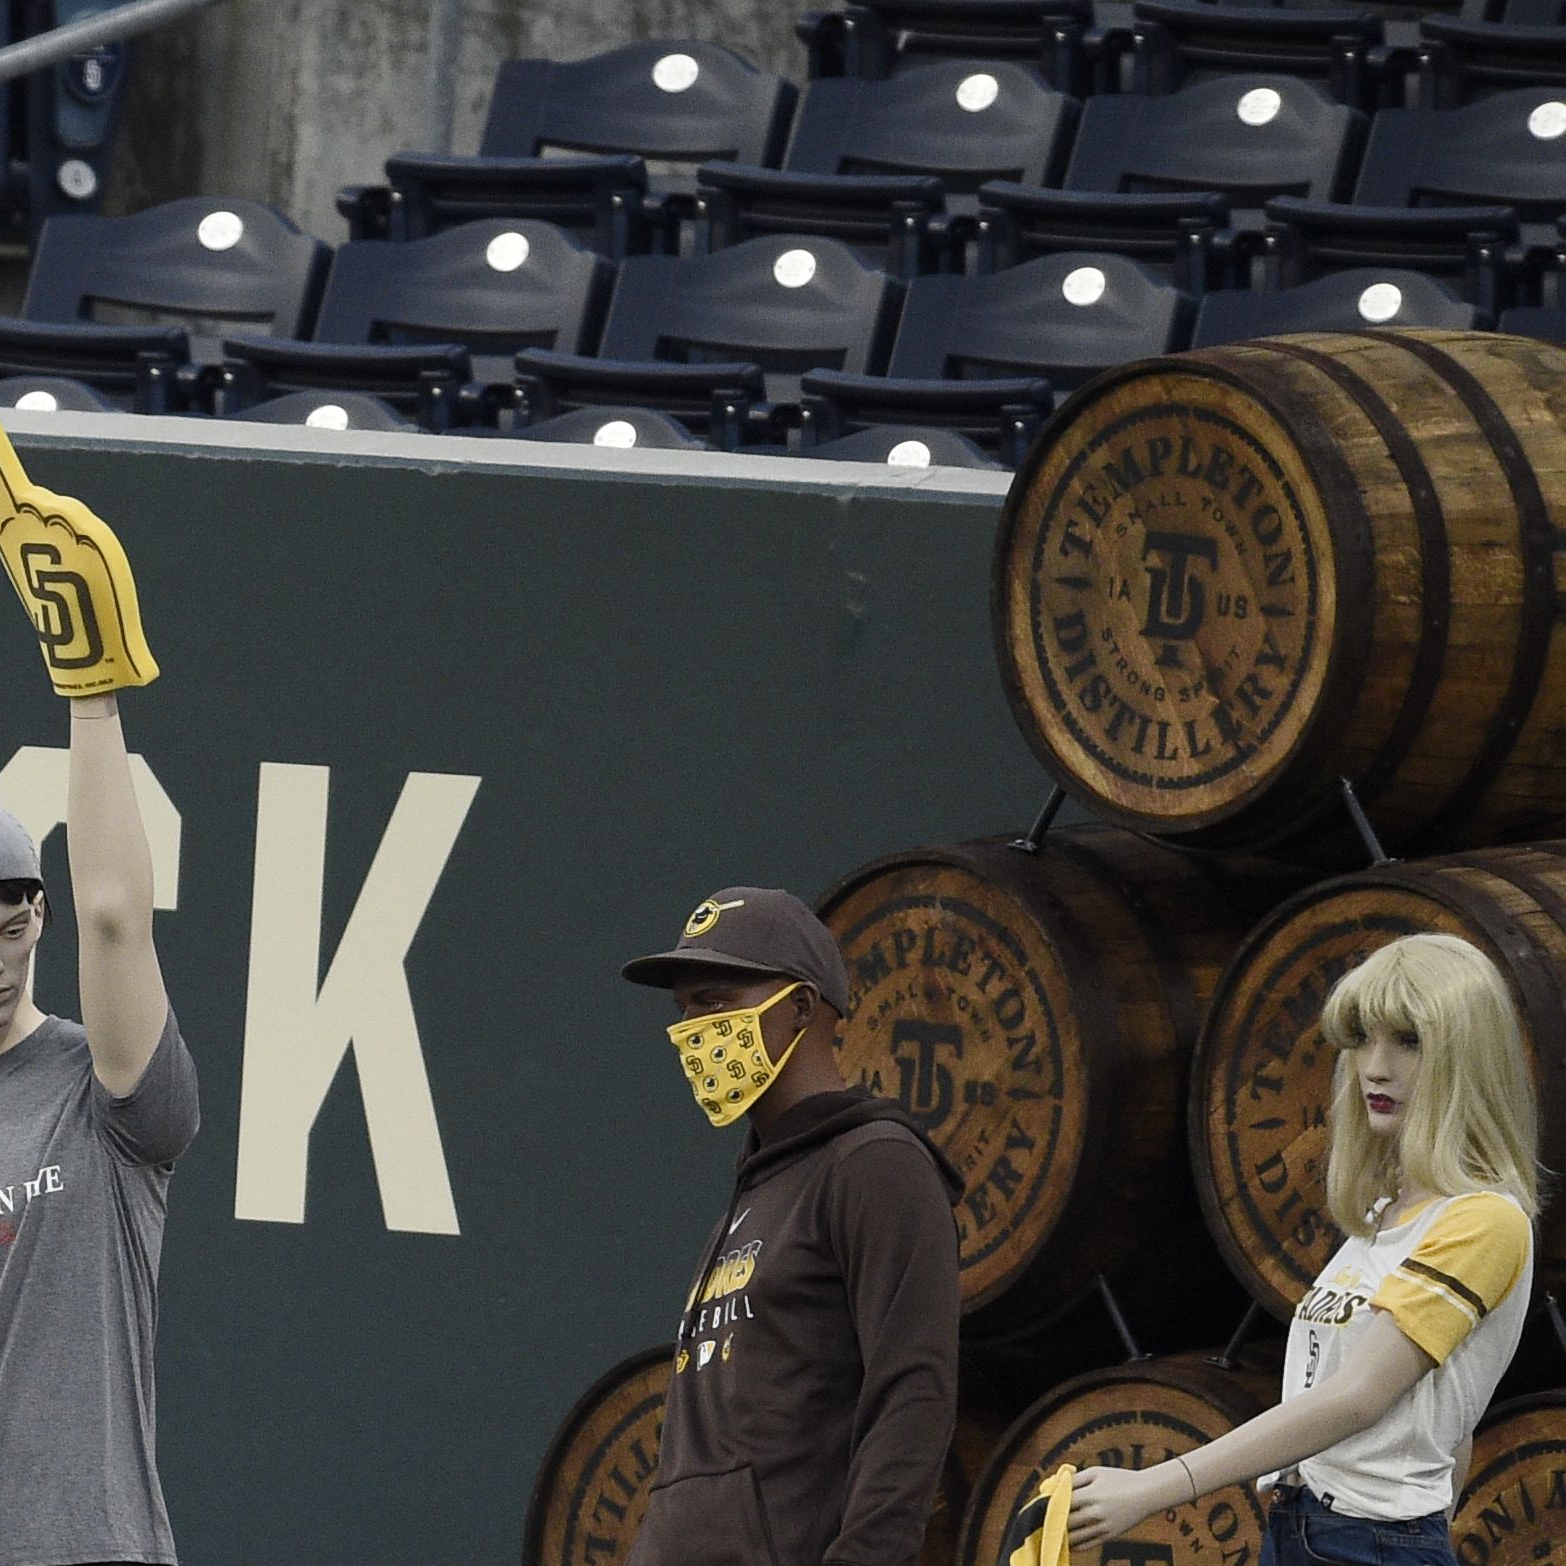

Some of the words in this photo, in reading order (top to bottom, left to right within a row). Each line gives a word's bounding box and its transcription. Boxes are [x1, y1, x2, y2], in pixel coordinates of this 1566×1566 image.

[1058, 433, 1296, 588] TEMPLETON
[834, 926, 1042, 1076] MPLETON
[1297, 1285, 1368, 1324] ADRES
